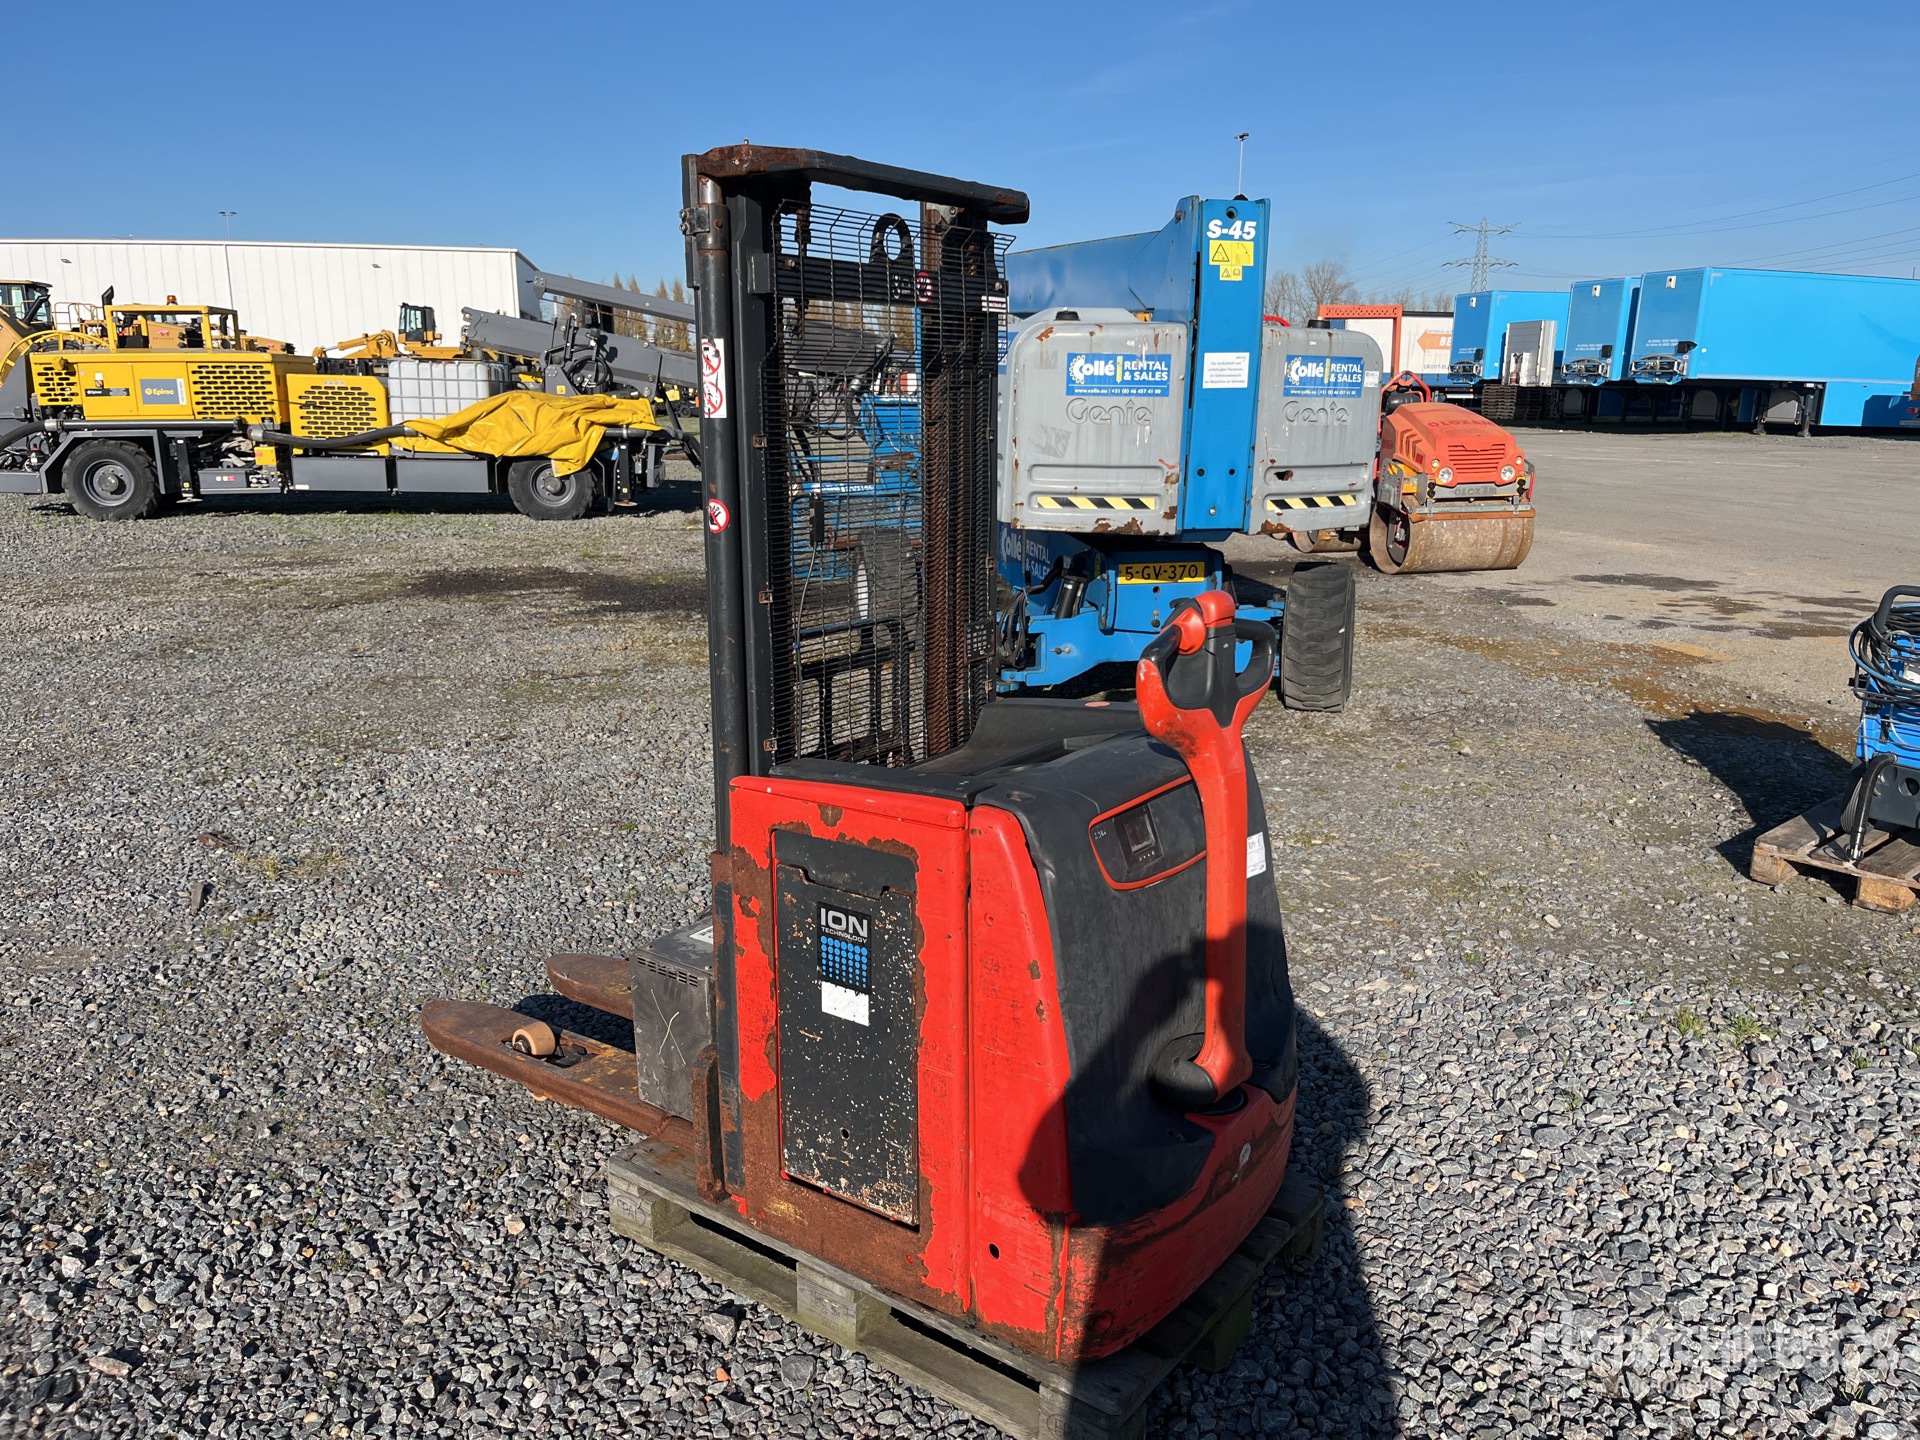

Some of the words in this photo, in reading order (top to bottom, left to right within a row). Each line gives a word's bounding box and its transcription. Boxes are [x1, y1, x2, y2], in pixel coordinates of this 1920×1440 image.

[1207, 219, 1257, 240] S-45
[1070, 356, 1115, 384] Collé
[1124, 361, 1168, 370] RENTAL
[1288, 358, 1324, 384] Collé
[1331, 364, 1362, 373] RENTAL
[1123, 371, 1132, 381] &
[1134, 371, 1168, 381] SALES
[1330, 374, 1336, 382] &
[1337, 374, 1362, 383] SALES
[152, 388, 175, 397] Epiroc
[1066, 397, 1152, 425] Genie
[1282, 400, 1350, 425] Genie
[1001, 529, 1022, 562] Collé
[1026, 539, 1050, 565] RENTAL
[1026, 558, 1030, 571] &
[1124, 564, 1199, 581] 5-GV-370
[821, 907, 868, 937] ION
[821, 926, 868, 943] TECHNOLOGY
